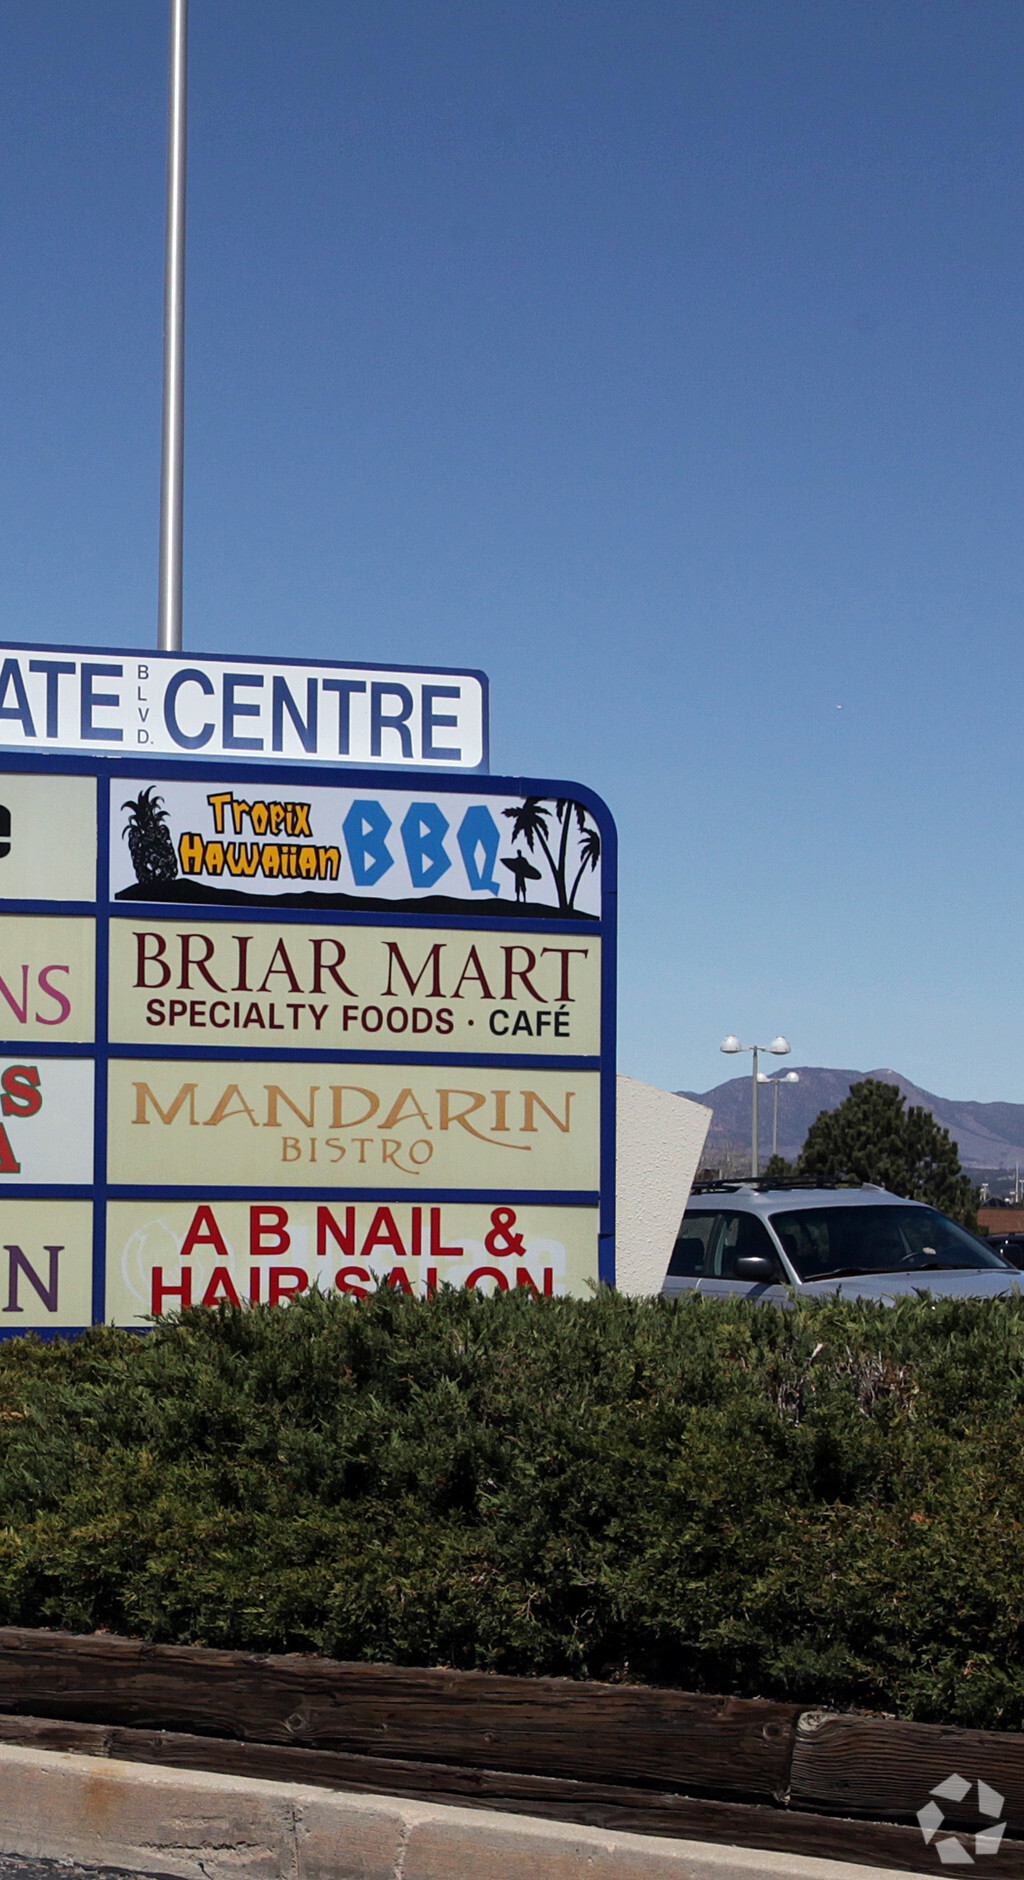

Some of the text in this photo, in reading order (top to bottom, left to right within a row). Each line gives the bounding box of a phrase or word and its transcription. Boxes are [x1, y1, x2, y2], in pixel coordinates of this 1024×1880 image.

[137, 664, 155, 745] BLVD.
[163, 668, 462, 761] CENTRE
[179, 832, 342, 881] Hawaiian
[207, 791, 500, 897] Tropix BBQ
[131, 931, 589, 1003] BRIAR MART
[145, 998, 571, 1037] SPECIALTY FOODS CAFÉ
[131, 1081, 576, 1150] MANDARIN
[281, 1136, 434, 1174] BISTRO
[317, 1206, 464, 1257] NAIL
[484, 1206, 527, 1258] &
